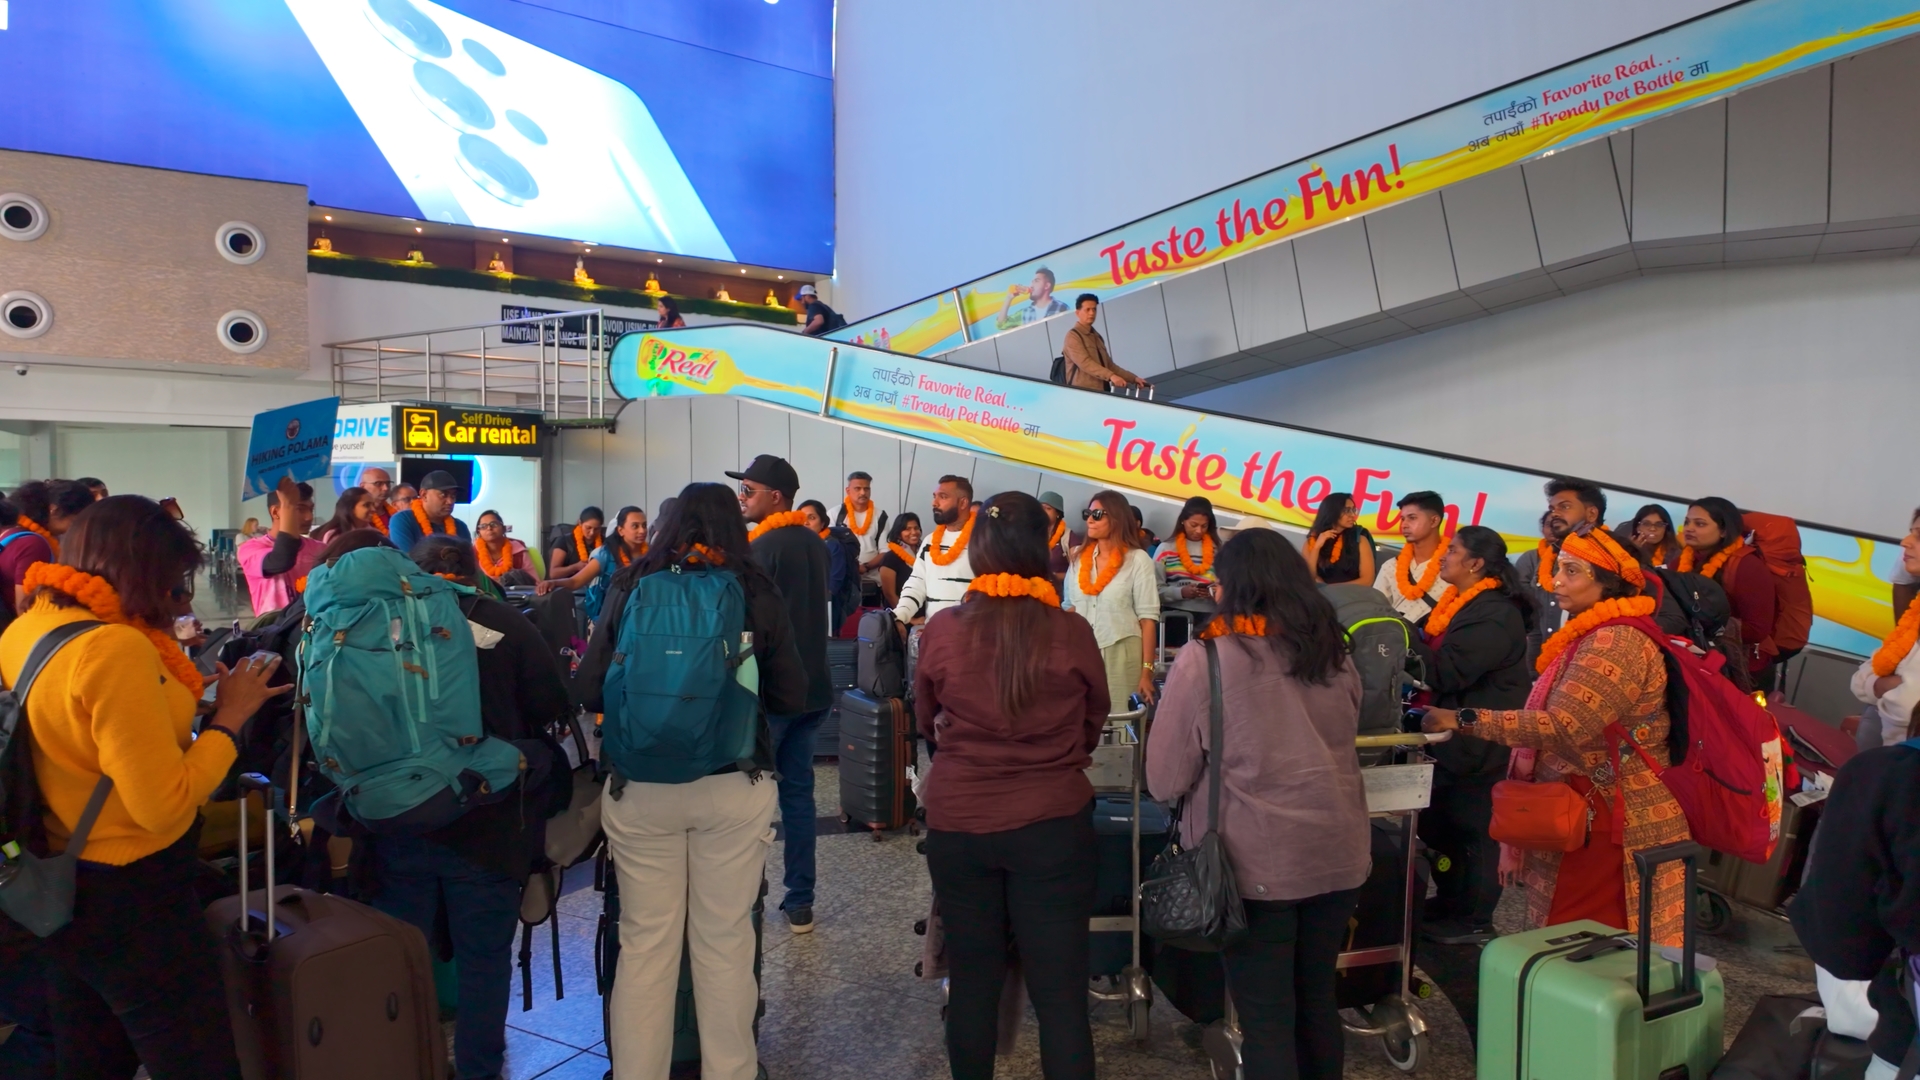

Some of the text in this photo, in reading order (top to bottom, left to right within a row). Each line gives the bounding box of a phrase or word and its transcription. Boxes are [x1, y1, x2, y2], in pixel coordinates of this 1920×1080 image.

[1541, 72, 1612, 106] Favorite
[1468, 134, 1490, 152] अब
[1531, 98, 1600, 131] #Trendy
[1603, 86, 1630, 106] Pet
[1633, 70, 1684, 96] Bottle
[1688, 60, 1709, 78] मा
[1100, 144, 1406, 286] Taste the Fun!
[503, 309, 520, 321] USE
[501, 326, 539, 340] MAINTAIN
[918, 374, 972, 400] Favorite
[462, 413, 512, 426] Self Drive
[853, 385, 871, 400] अब
[902, 394, 955, 421] #Trendy
[957, 406, 979, 424] Pet
[981, 411, 1020, 433] Bottle
[1023, 422, 1041, 438] मा
[340, 441, 365, 452] yourself
[444, 421, 537, 444] Car rental
[251, 435, 329, 466] HIKING POLAMA
[1103, 418, 1227, 491] Taste
[1240, 450, 1331, 515] the
